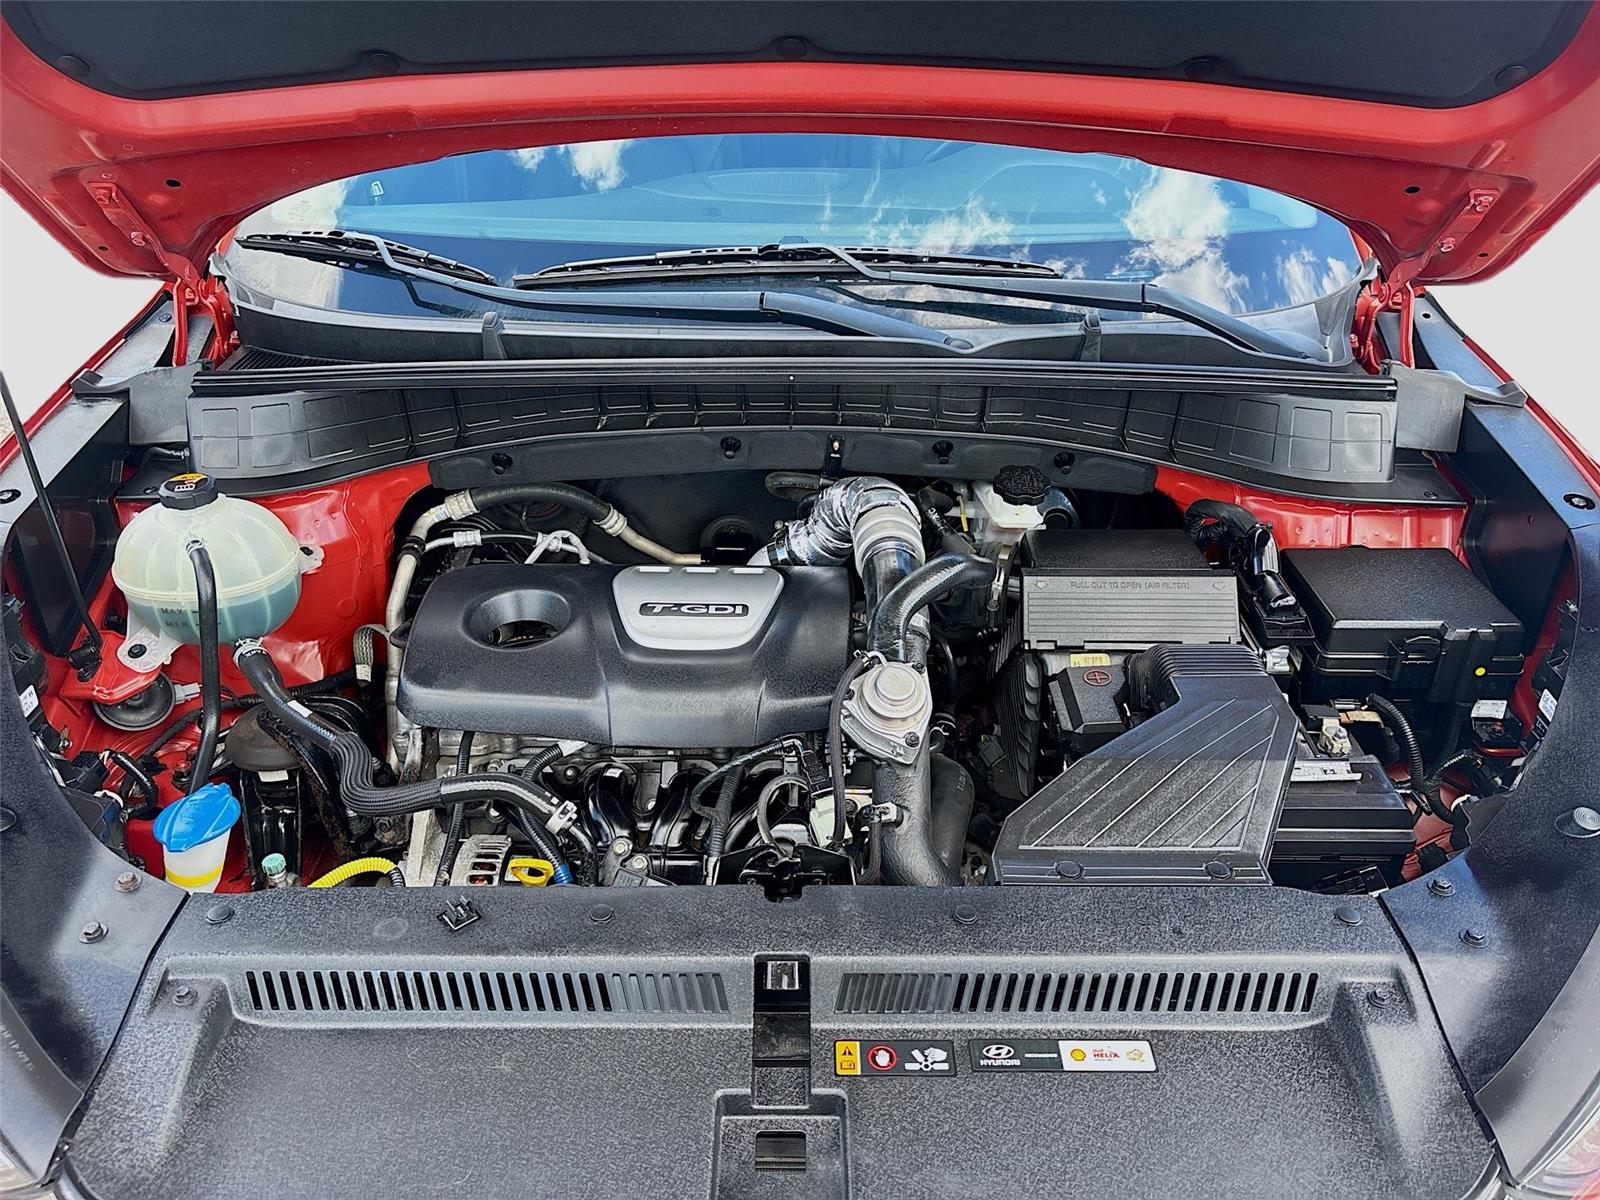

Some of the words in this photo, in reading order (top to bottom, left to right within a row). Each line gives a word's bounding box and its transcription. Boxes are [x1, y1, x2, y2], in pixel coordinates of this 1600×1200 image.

[1070, 581, 1090, 589] PULL
[1091, 581, 1107, 589] OUT
[1108, 581, 1119, 589] TO
[1120, 581, 1141, 589] OPEN
[647, 603, 743, 614] T-GDI
